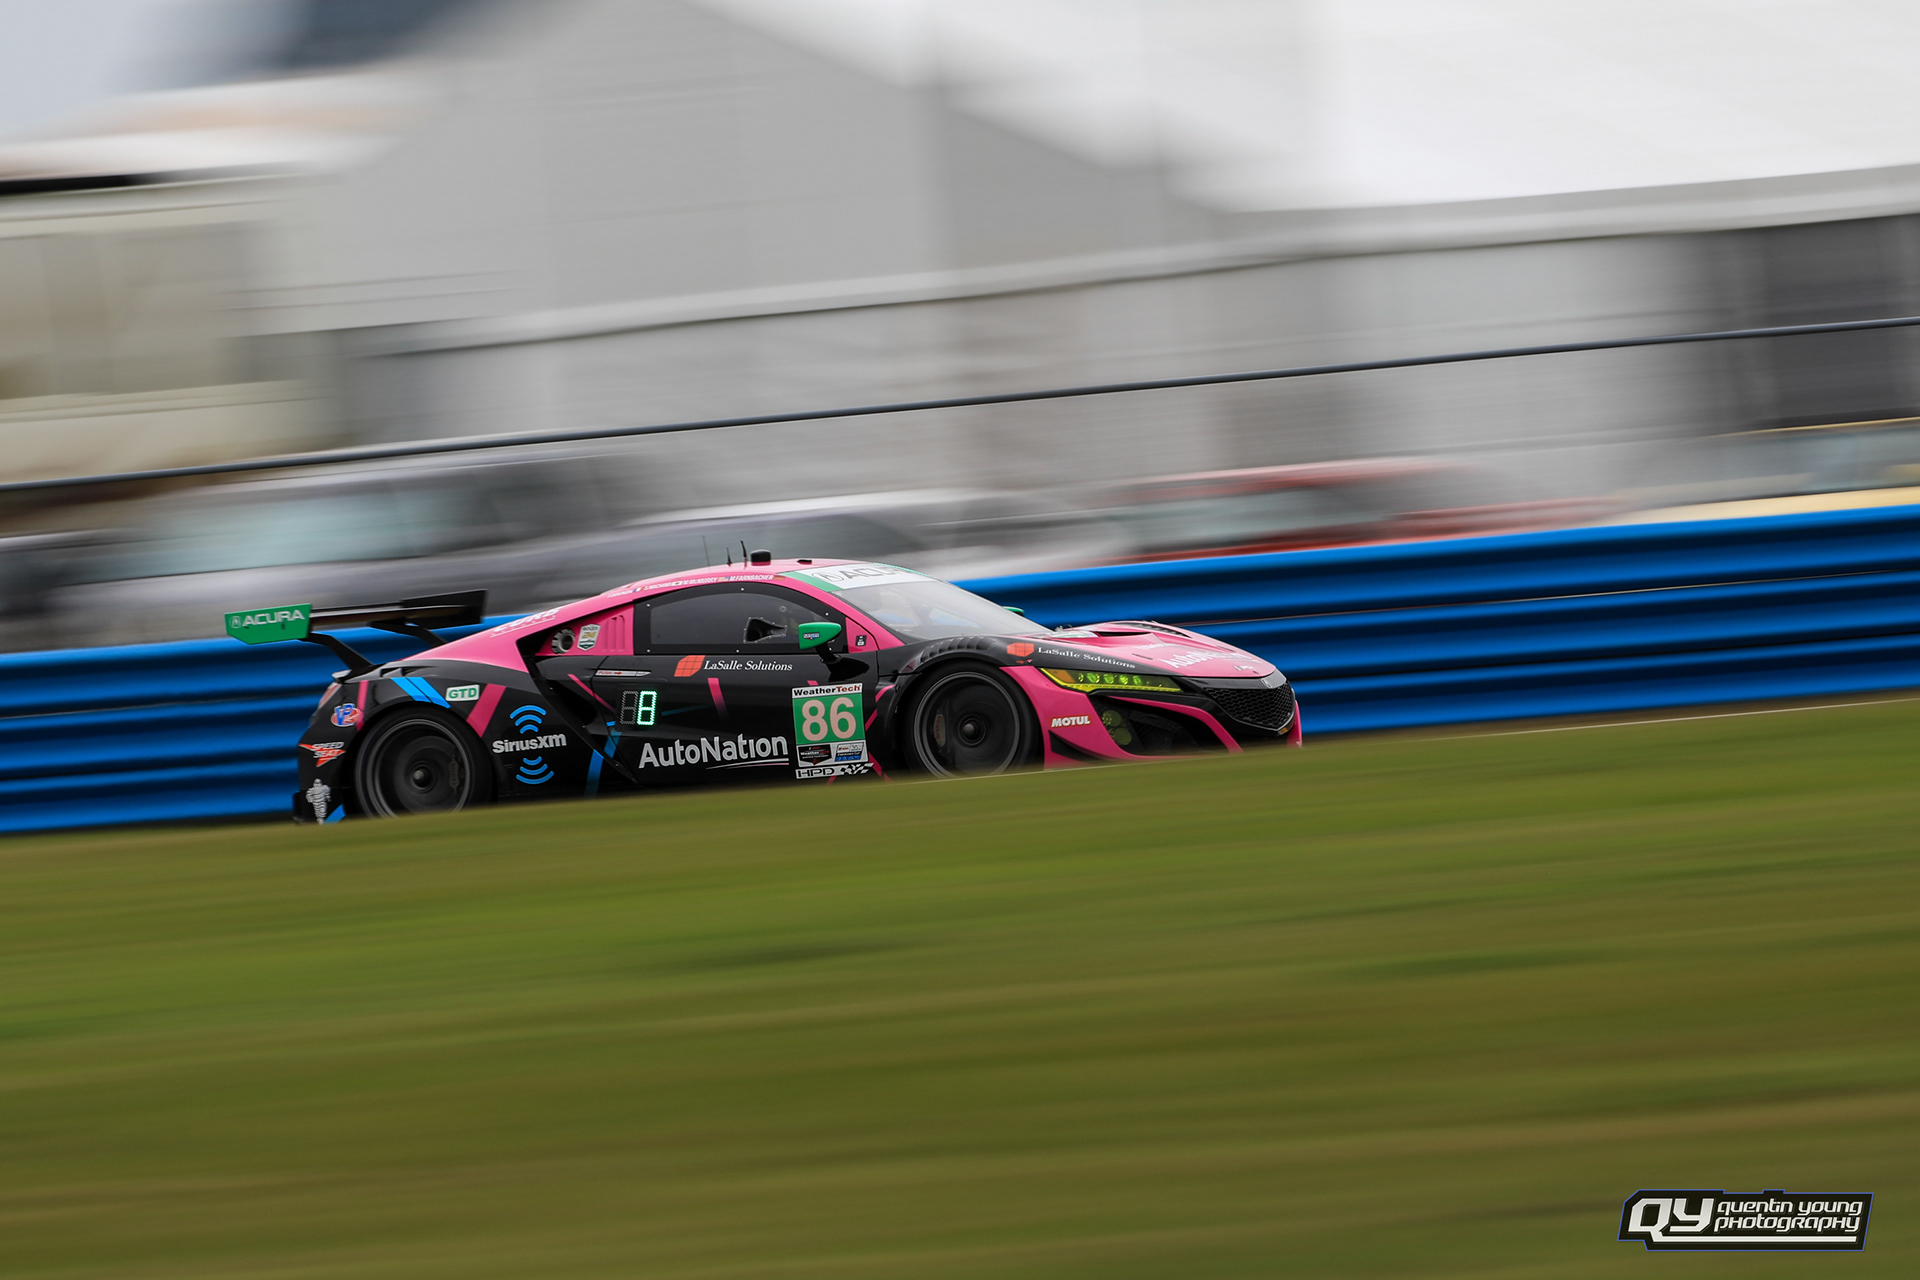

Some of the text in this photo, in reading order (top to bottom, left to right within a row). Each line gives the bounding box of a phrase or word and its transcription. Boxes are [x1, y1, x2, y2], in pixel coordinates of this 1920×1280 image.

[241, 609, 306, 627] ACURA
[1038, 647, 1136, 669] LaSalle Solutions
[703, 660, 793, 671] LaSalle Solutions
[448, 687, 477, 699] GTD
[793, 684, 862, 696] WeatherTech
[801, 696, 857, 742] 86
[1051, 715, 1091, 727] MOTUL
[638, 733, 789, 769] AutoNation
[798, 767, 835, 778] HPD
